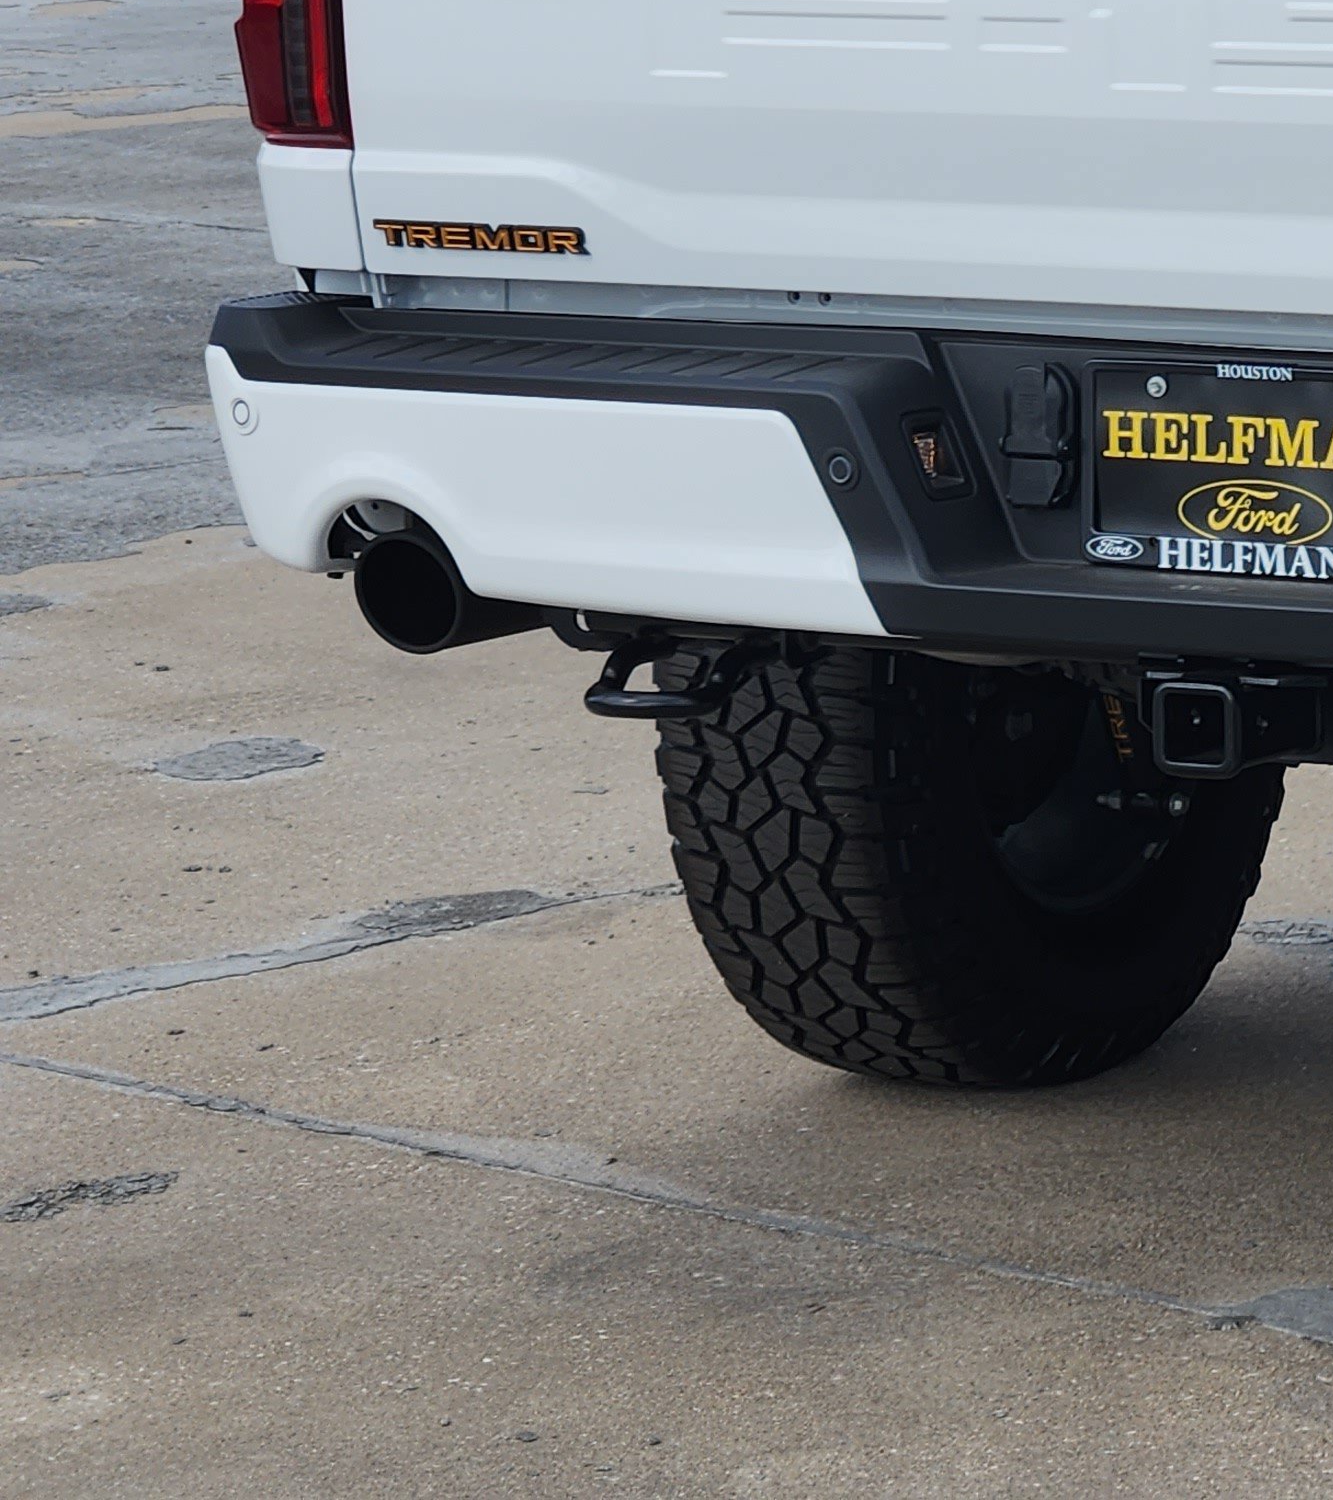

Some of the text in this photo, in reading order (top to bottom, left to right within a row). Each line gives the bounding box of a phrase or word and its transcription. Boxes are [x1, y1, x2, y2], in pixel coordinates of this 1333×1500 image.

[373, 218, 591, 256] TREMOR
[1216, 363, 1294, 382] HOUSTON
[1206, 486, 1302, 536] Ford
[1095, 538, 1134, 558] Ford
